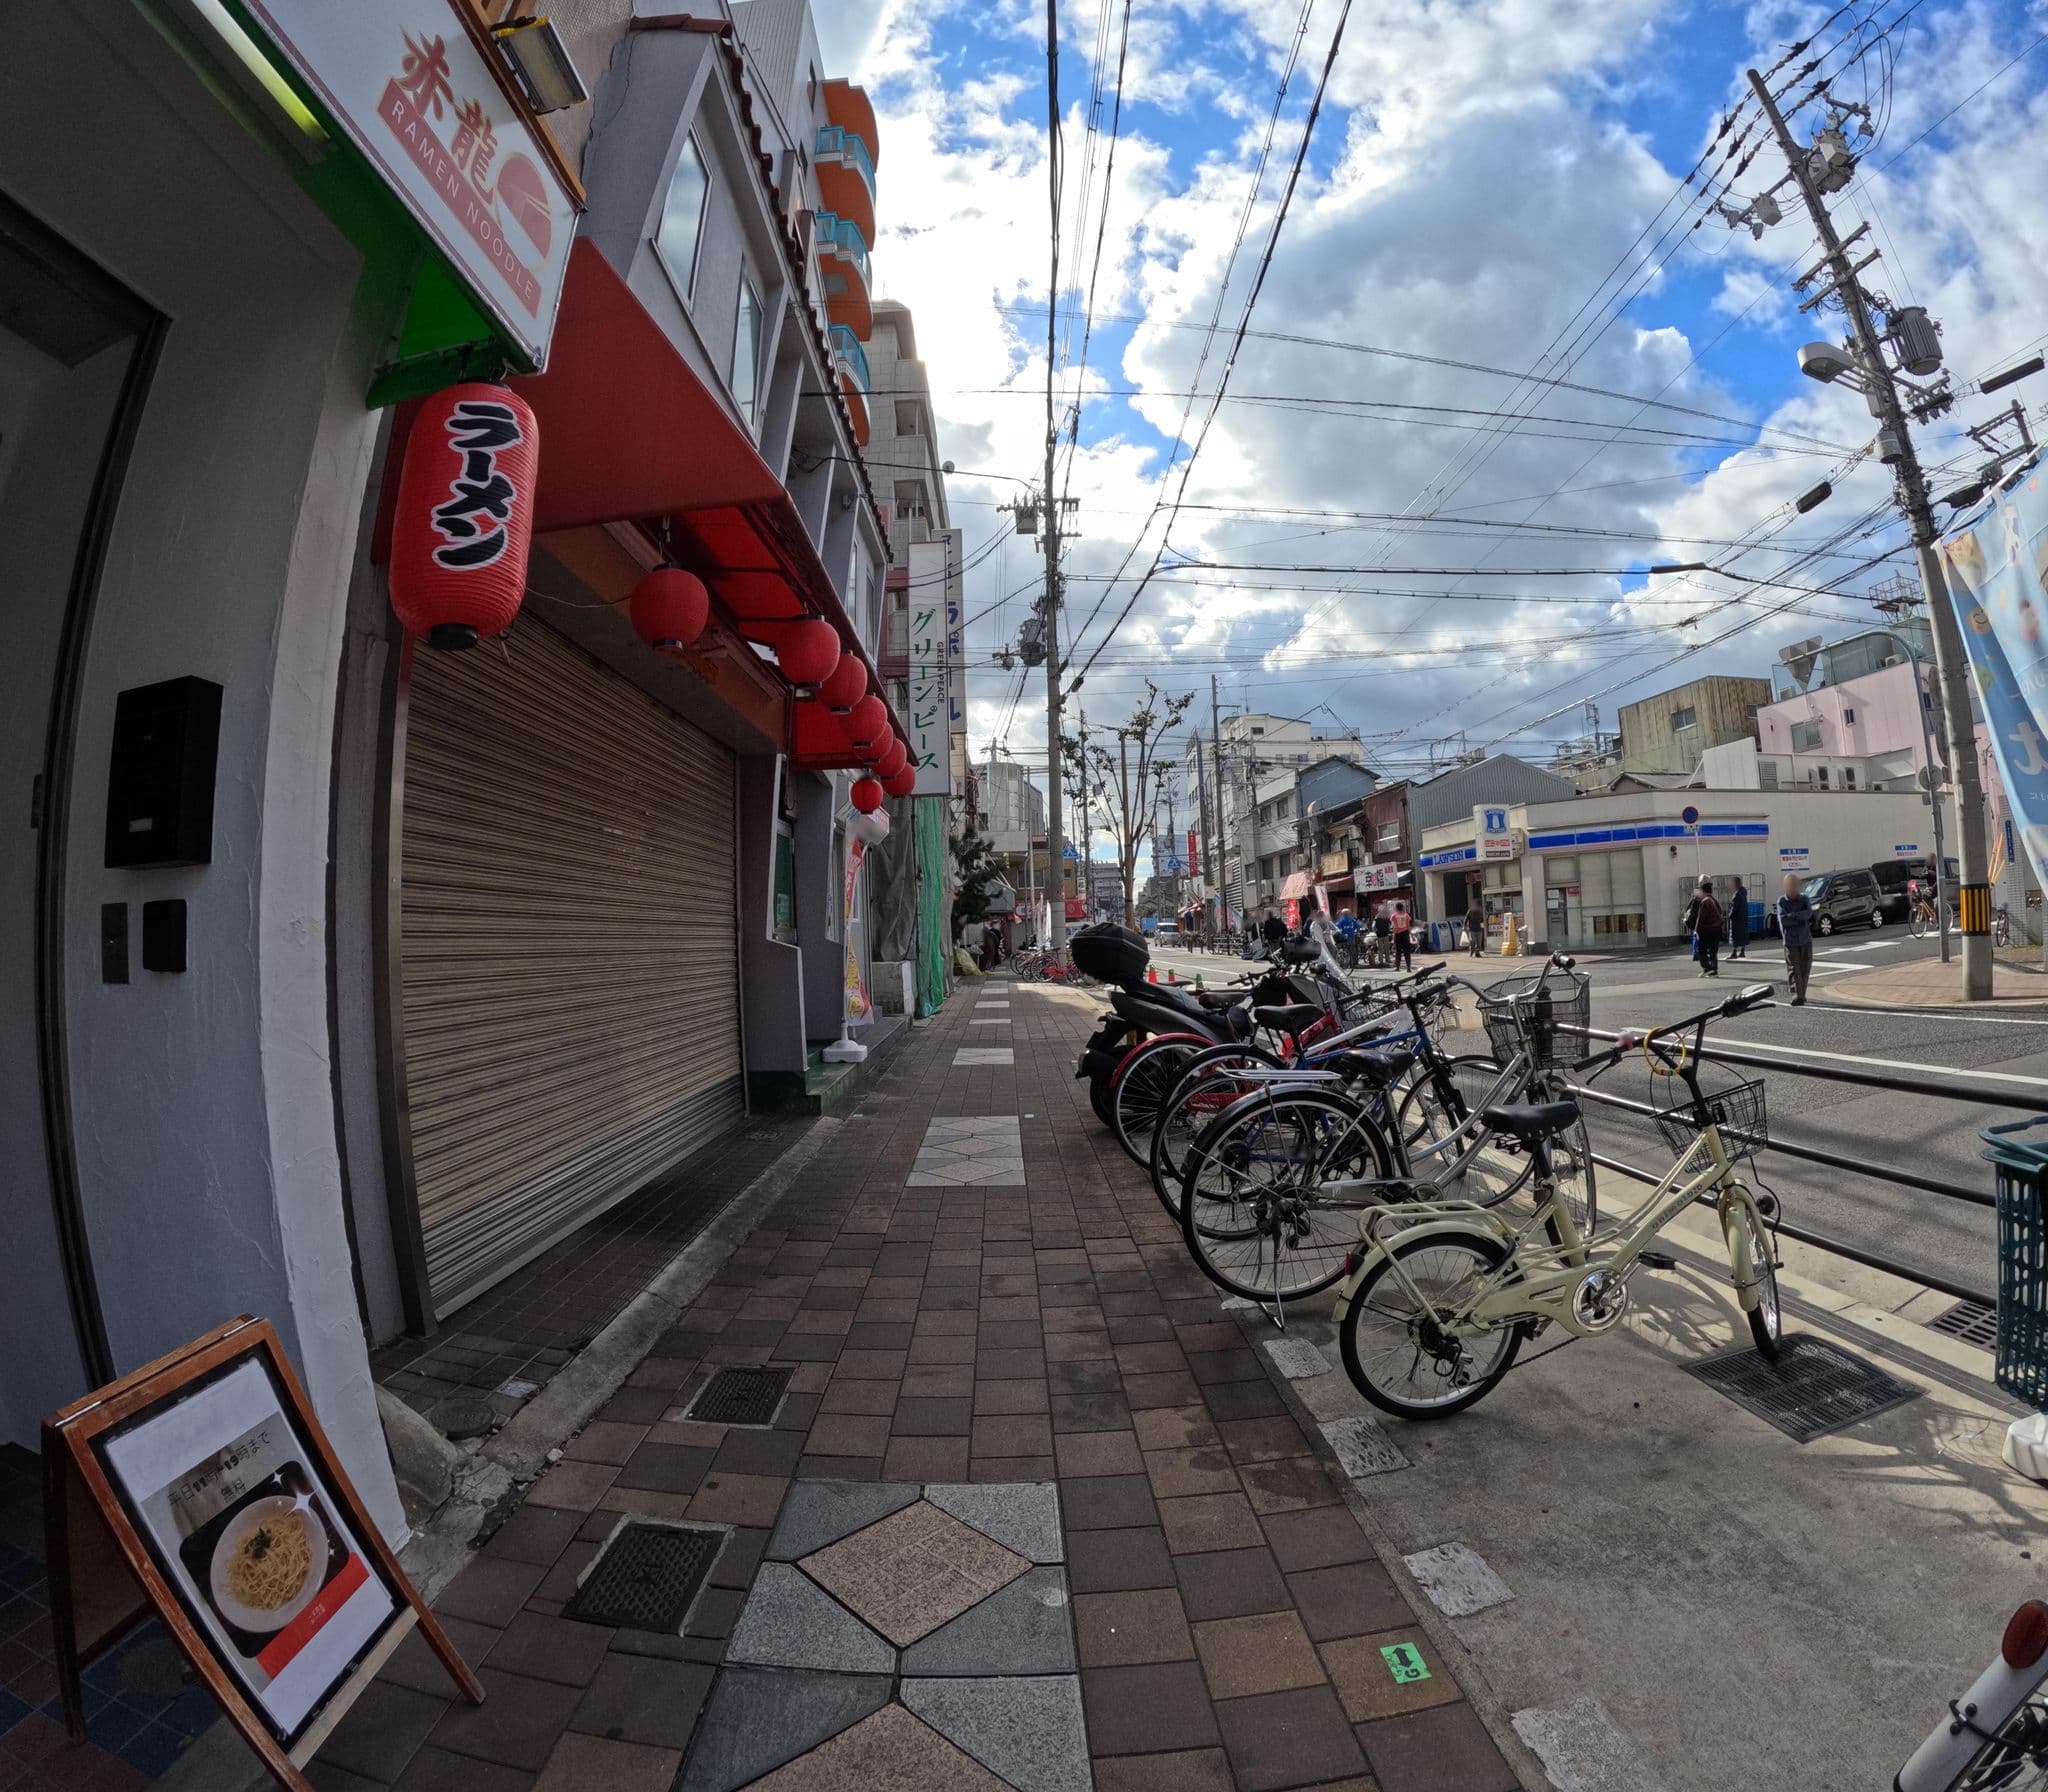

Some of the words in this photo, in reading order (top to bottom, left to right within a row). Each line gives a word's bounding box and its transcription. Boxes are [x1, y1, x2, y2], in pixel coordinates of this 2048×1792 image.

[391, 100, 459, 199] RAMEN
[466, 201, 533, 298] NOODLE
[432, 402, 523, 569] ラーメン
[911, 608, 939, 772] グリーンピース
[936, 642, 945, 671] GREEN
[937, 674, 945, 705] PEACE
[1432, 850, 1465, 866] LAWSON
